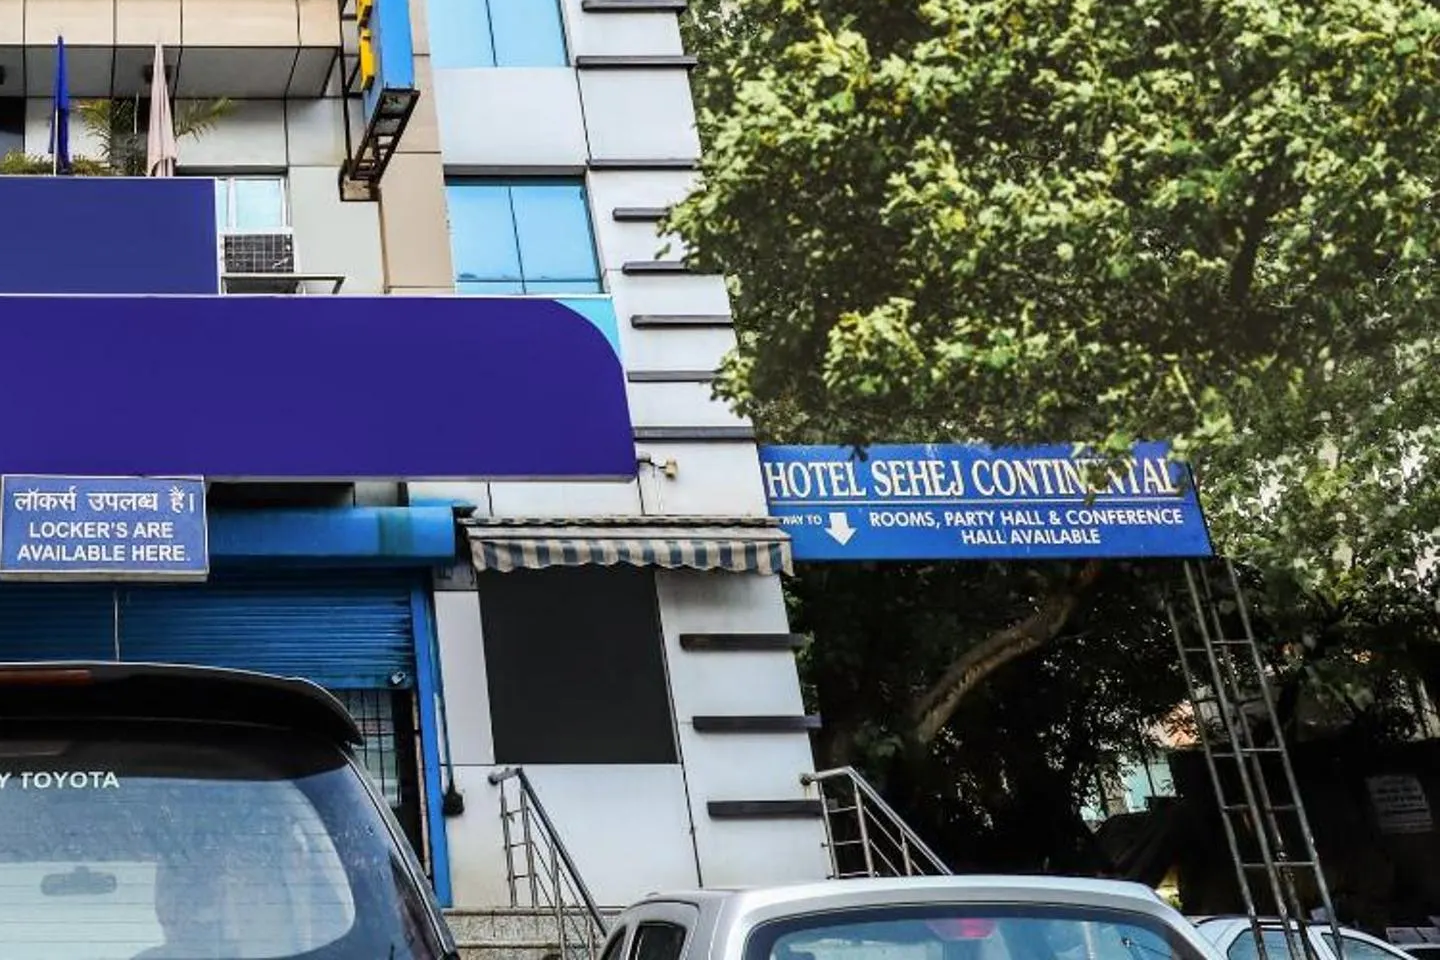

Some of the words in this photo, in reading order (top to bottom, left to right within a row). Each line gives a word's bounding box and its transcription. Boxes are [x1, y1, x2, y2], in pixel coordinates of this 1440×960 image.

[763, 461, 867, 498] HOTEL
[870, 459, 965, 498] SEHEJ
[13, 485, 78, 512] लॉकर्स
[86, 492, 159, 512] उपलब्ध
[806, 514, 823, 525] TO
[868, 511, 941, 529] ROOMS,
[944, 510, 995, 527] PARTY
[1001, 510, 1045, 526] HALL
[1048, 510, 1061, 525] &
[1065, 508, 1184, 526] CONFERENCE
[29, 521, 129, 539] LOCKER'S
[133, 521, 174, 538] ARE
[962, 529, 1007, 545] HALL
[1010, 528, 1102, 545] AVAILABLE
[16, 544, 126, 562] AVAILABLE
[20, 771, 121, 789] TOYOTA
